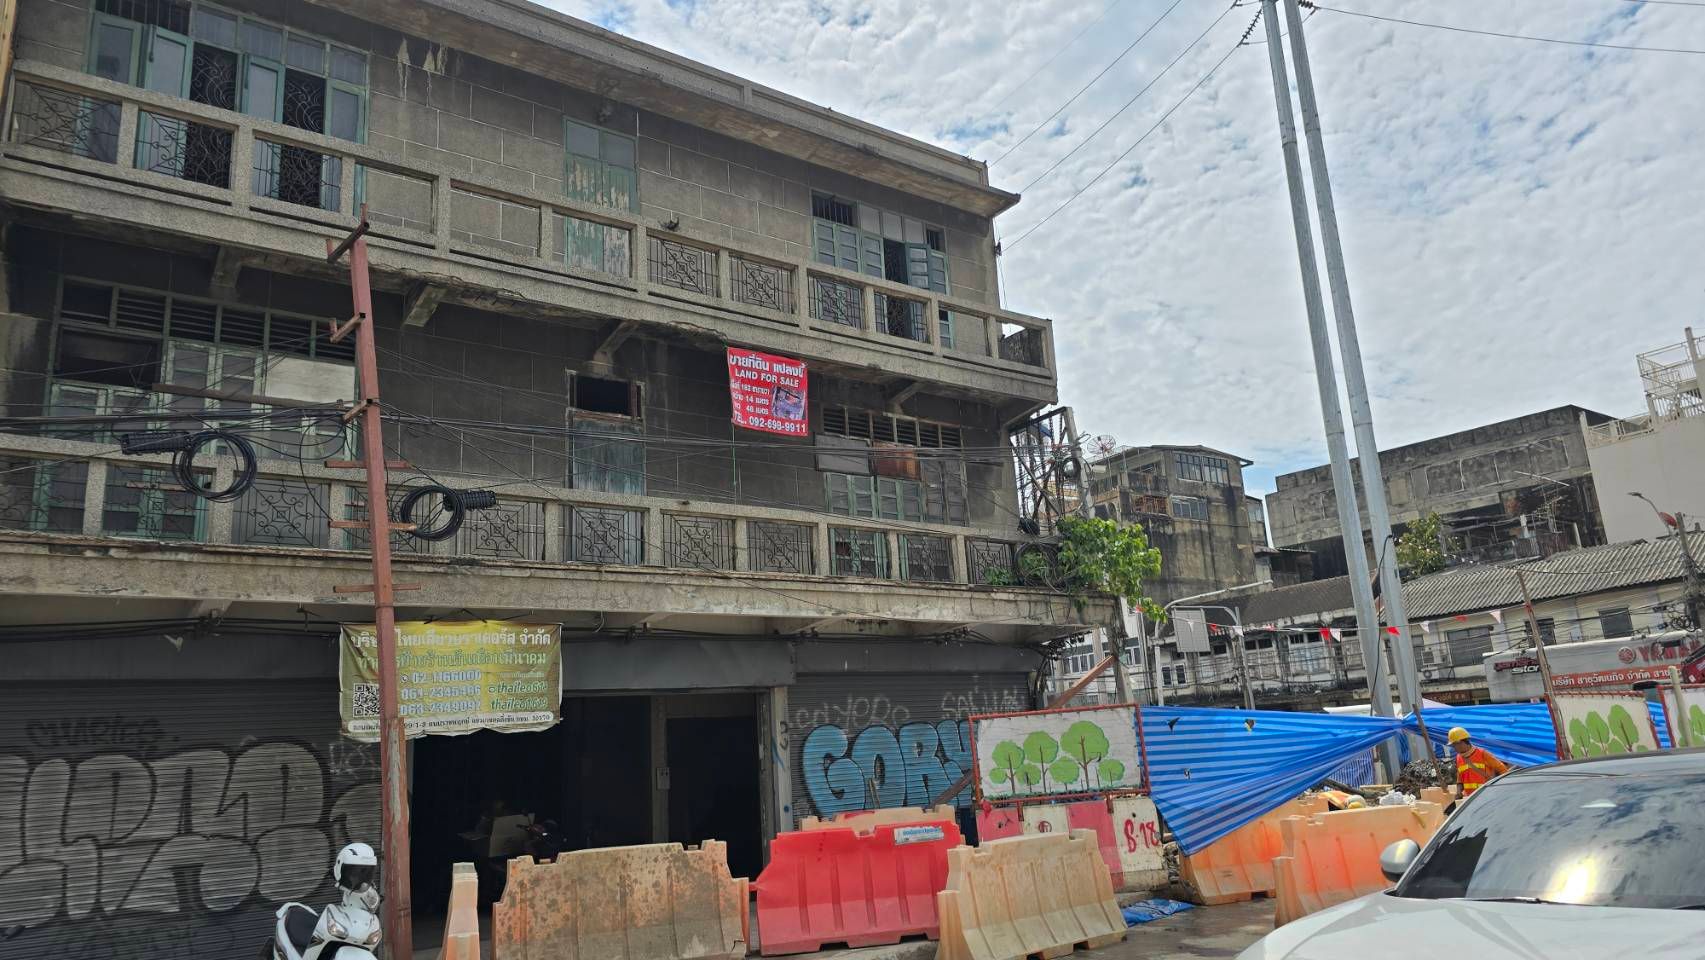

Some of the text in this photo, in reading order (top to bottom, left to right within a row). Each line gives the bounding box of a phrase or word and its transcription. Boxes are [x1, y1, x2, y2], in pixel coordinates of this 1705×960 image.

[729, 354, 770, 371] ขายที่ดิน
[735, 368, 799, 388] LAND FOR SALE
[519, 626, 551, 646] จำกัด
[1552, 674, 1575, 687] บริษัท
[1626, 669, 1651, 681] จำกัด
